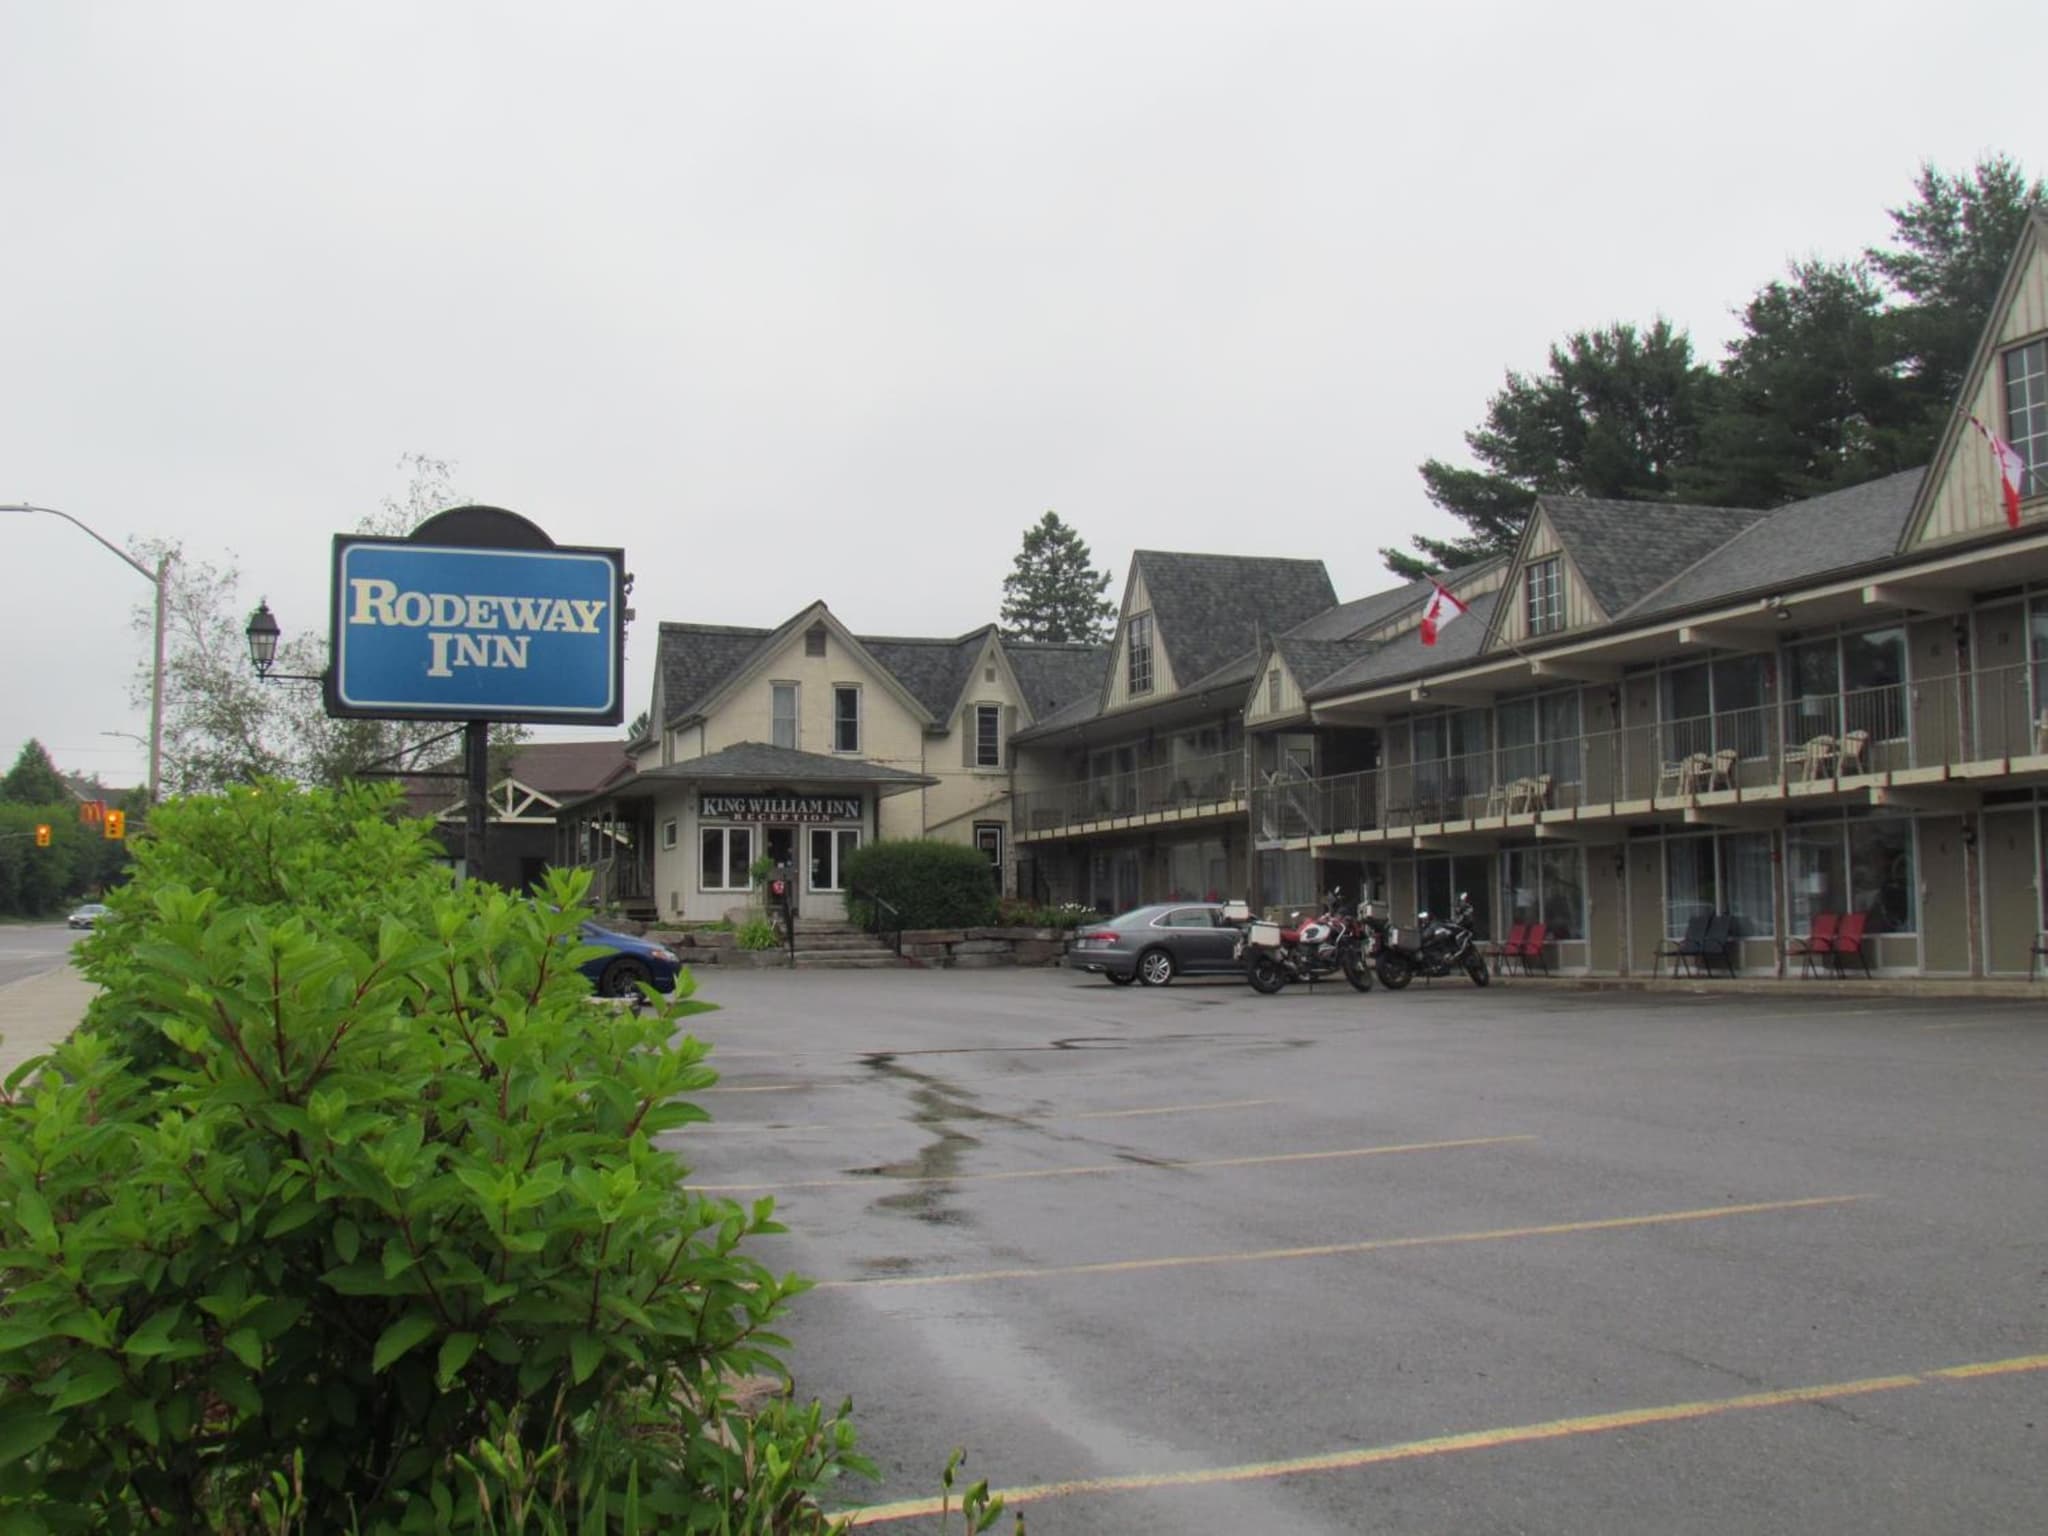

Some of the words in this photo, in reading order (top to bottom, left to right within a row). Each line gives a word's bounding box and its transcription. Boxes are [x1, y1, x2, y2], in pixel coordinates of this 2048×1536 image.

[350, 578, 606, 633] RODEWAY
[427, 632, 531, 677] INN
[703, 798, 746, 816] KING
[748, 799, 822, 814] WILLIAM
[826, 800, 859, 818] INN
[733, 813, 831, 822] RECEPTION
